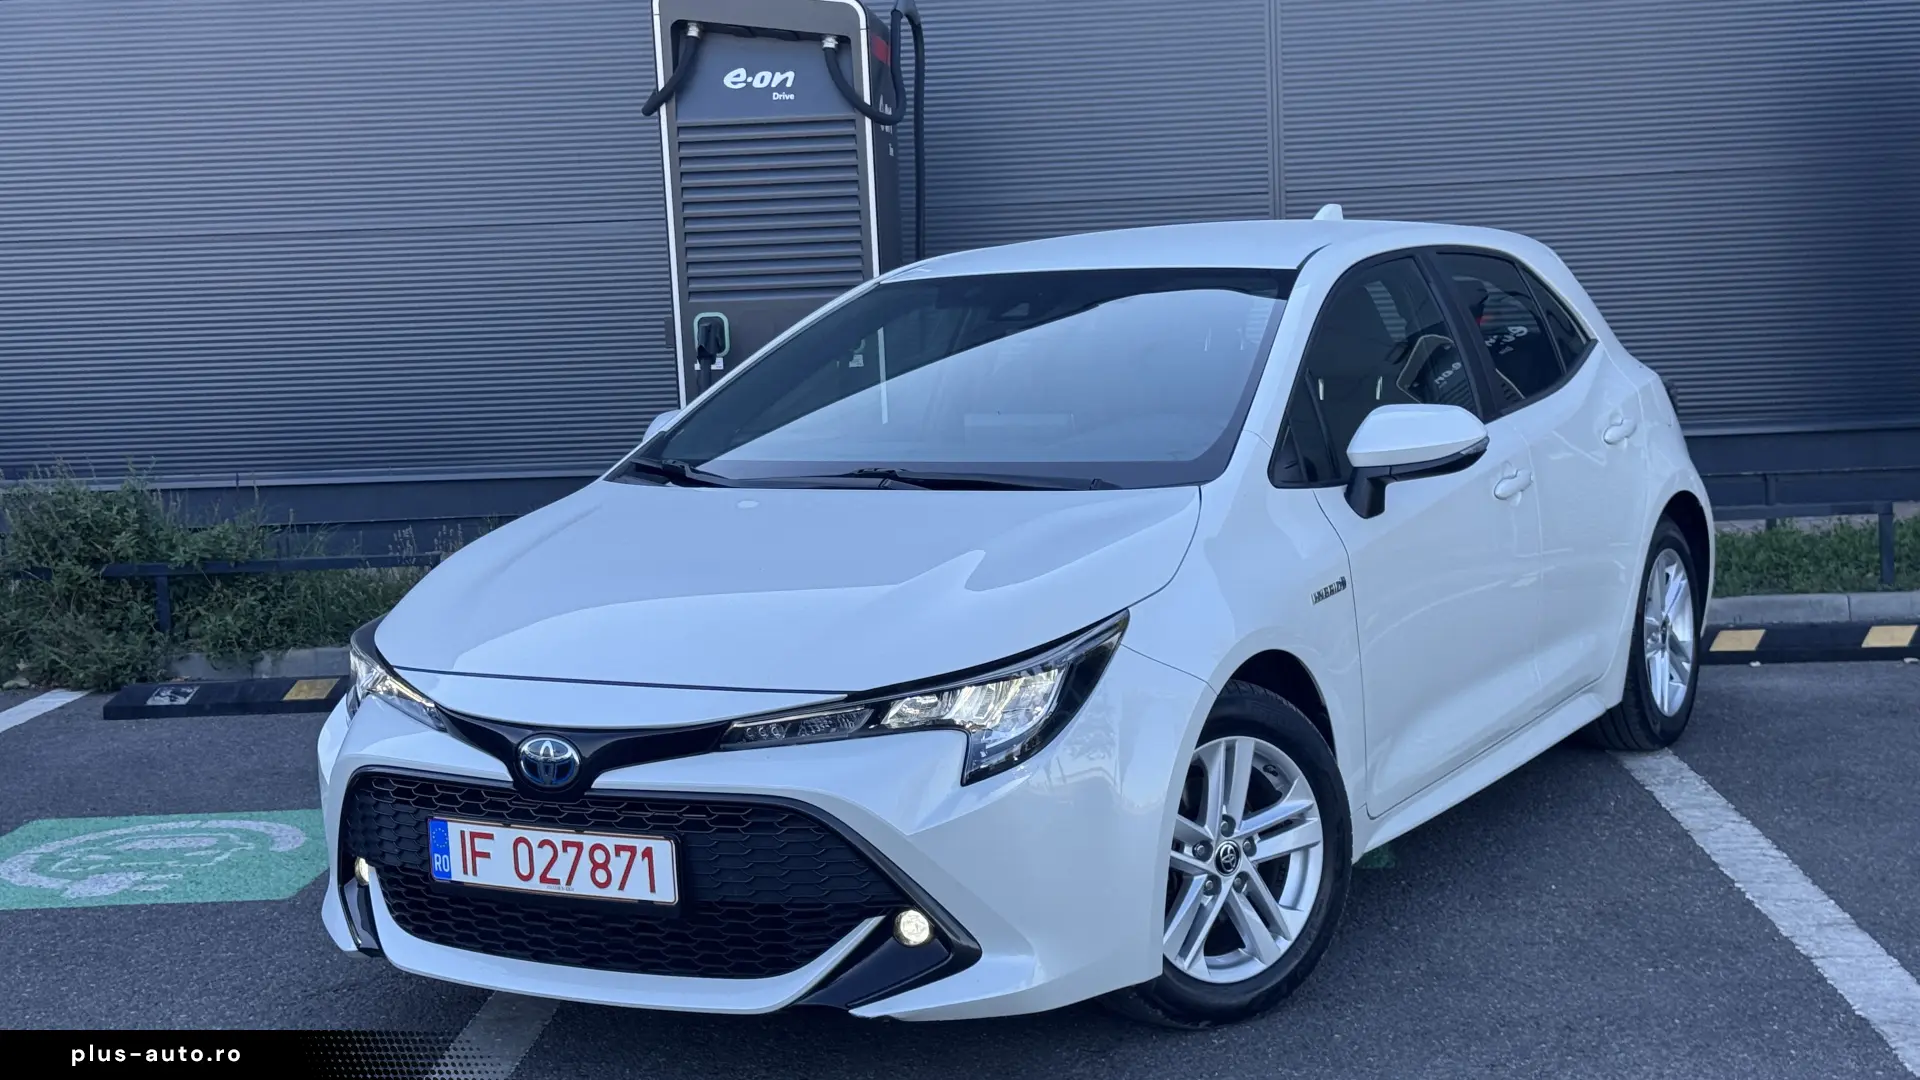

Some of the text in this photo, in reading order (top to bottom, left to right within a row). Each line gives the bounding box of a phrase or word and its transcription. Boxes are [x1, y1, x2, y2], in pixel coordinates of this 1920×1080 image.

[772, 91, 796, 101] Drive
[434, 853, 451, 873] RO
[460, 829, 657, 894] IF 027871
